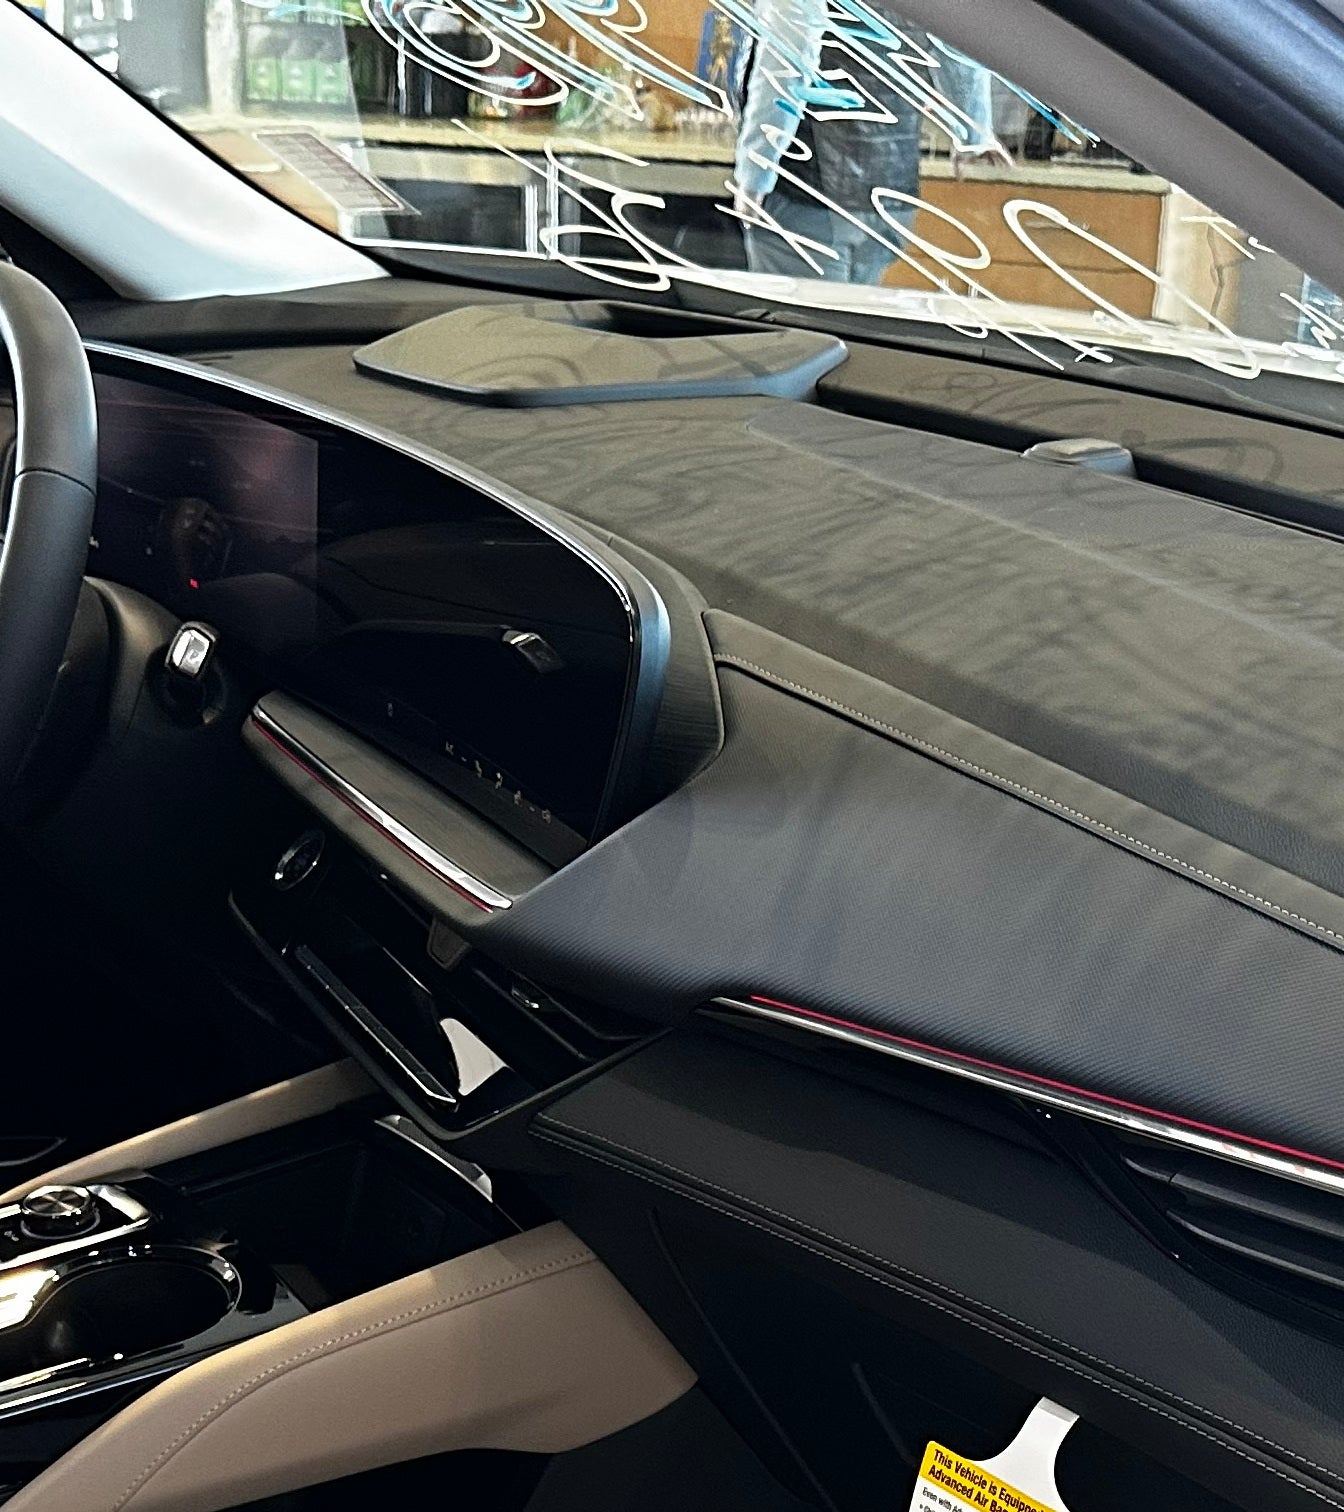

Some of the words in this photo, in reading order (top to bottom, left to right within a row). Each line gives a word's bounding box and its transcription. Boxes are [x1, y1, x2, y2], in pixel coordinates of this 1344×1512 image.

[928, 1465, 973, 1500] Advanced
[973, 1491, 989, 1509] Air
[934, 1449, 952, 1470] This
[955, 1462, 987, 1489] Vehicle
